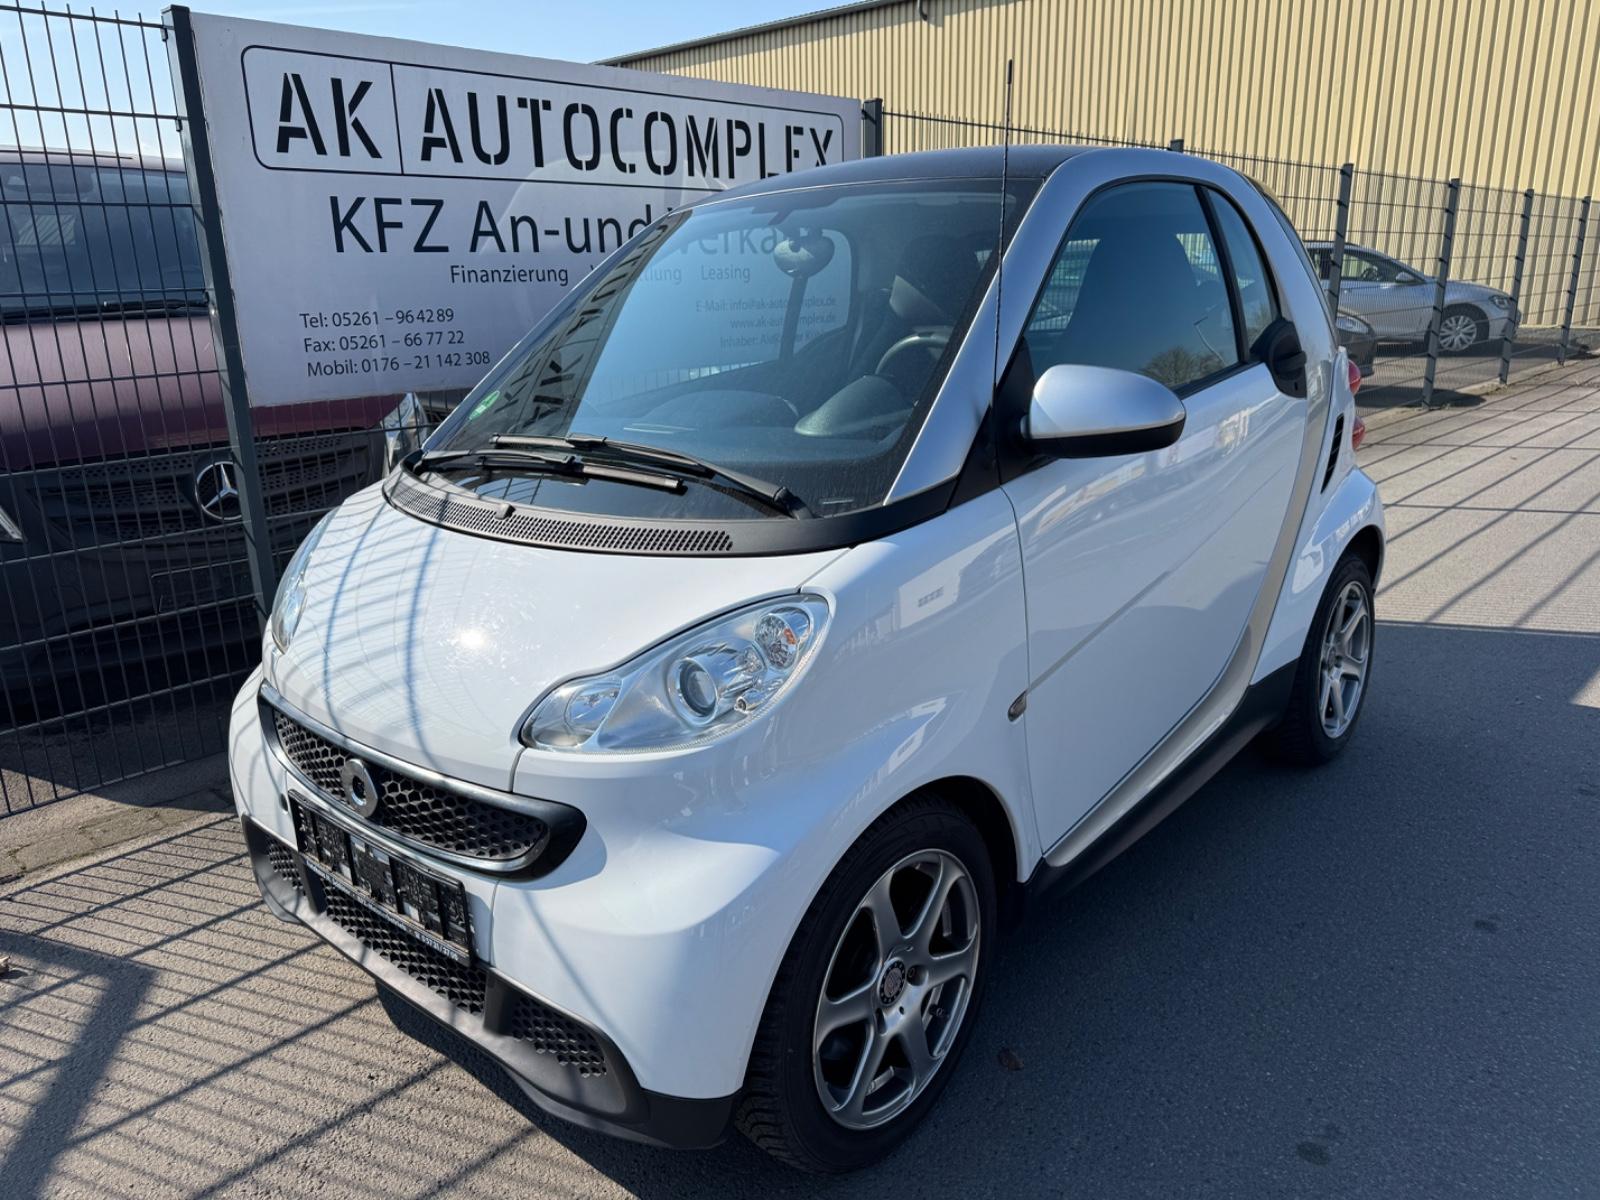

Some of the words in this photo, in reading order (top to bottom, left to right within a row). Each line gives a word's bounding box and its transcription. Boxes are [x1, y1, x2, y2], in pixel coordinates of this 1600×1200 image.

[276, 72, 383, 158] AK
[420, 87, 834, 180] AUTOCOMPLEX
[329, 195, 450, 253] KFZ
[450, 264, 569, 287] Finanzierung
[700, 264, 751, 282] Leasing
[299, 312, 328, 329] Tel:
[332, 311, 379, 327] 05261
[303, 337, 336, 353] Fax:
[339, 334, 386, 351] 05261
[307, 359, 358, 377] Mobil:
[361, 356, 400, 374] 0176
[437, 352, 462, 368] 142
[465, 350, 491, 365] 308
